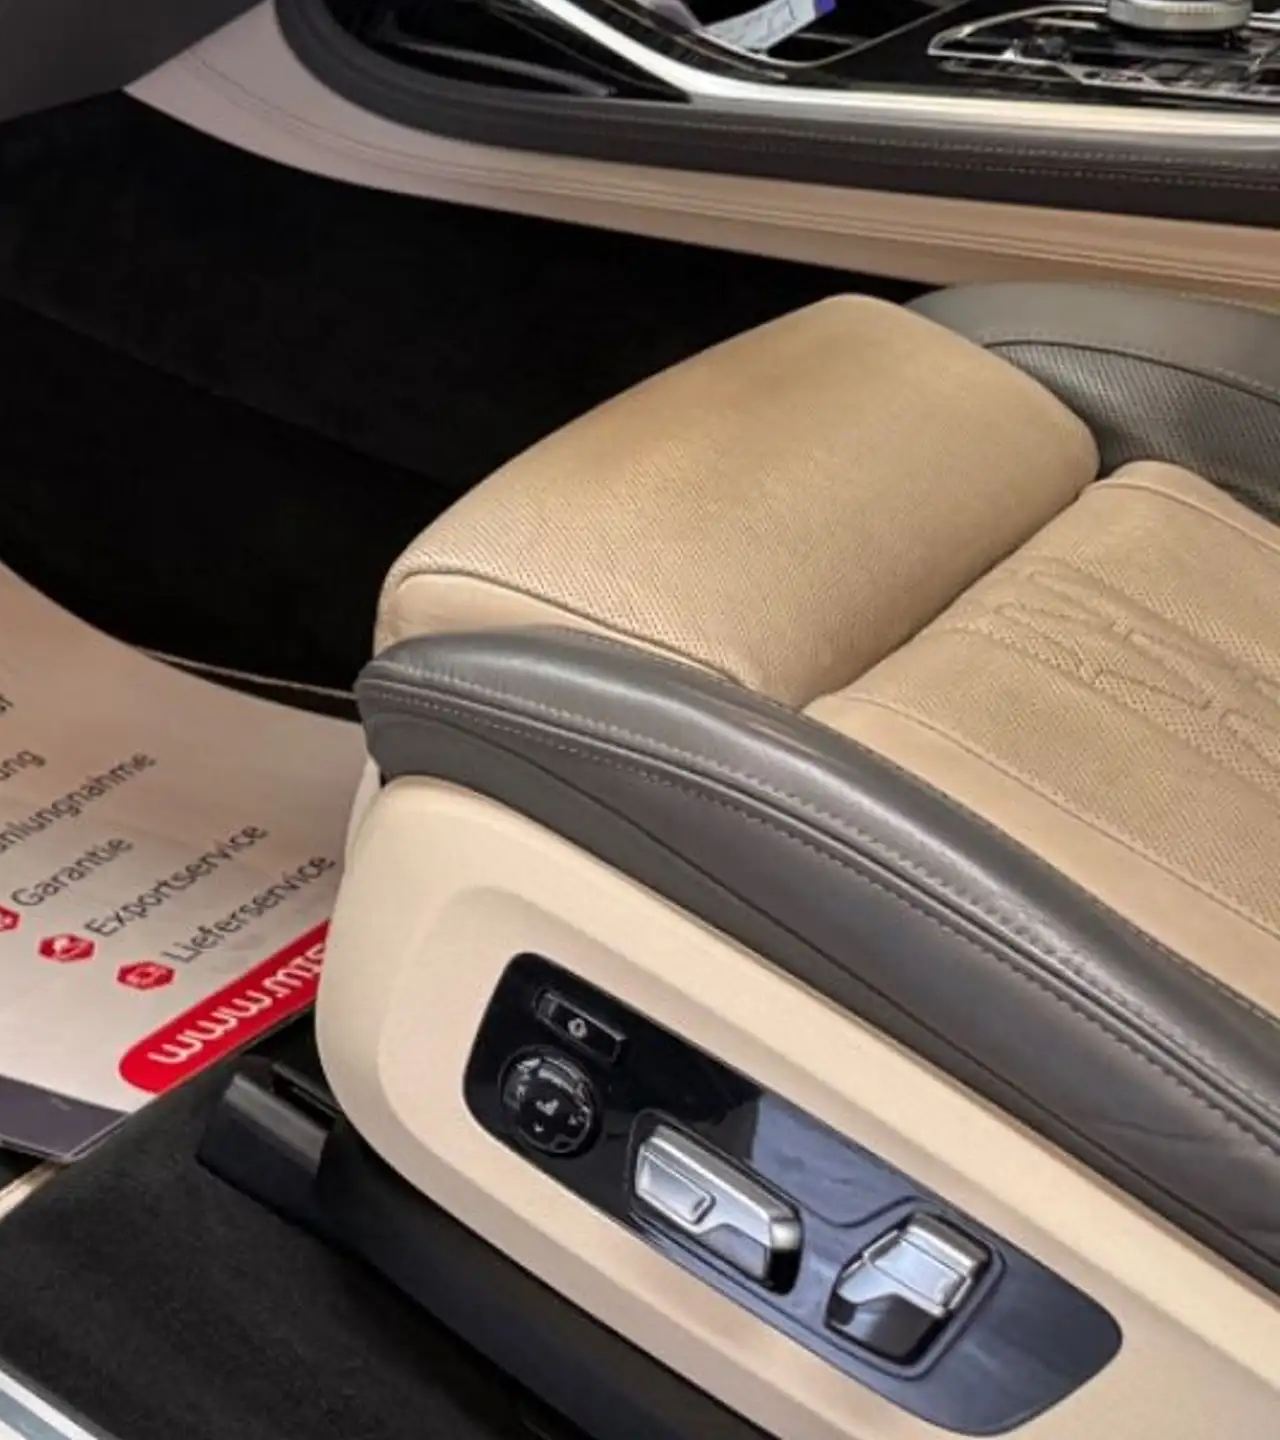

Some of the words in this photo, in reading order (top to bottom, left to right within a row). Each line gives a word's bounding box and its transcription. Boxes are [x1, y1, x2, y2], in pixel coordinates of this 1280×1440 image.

[10, 836, 135, 907] Garantie
[83, 823, 270, 938] Exportservice
[159, 854, 337, 965] Lieferservice
